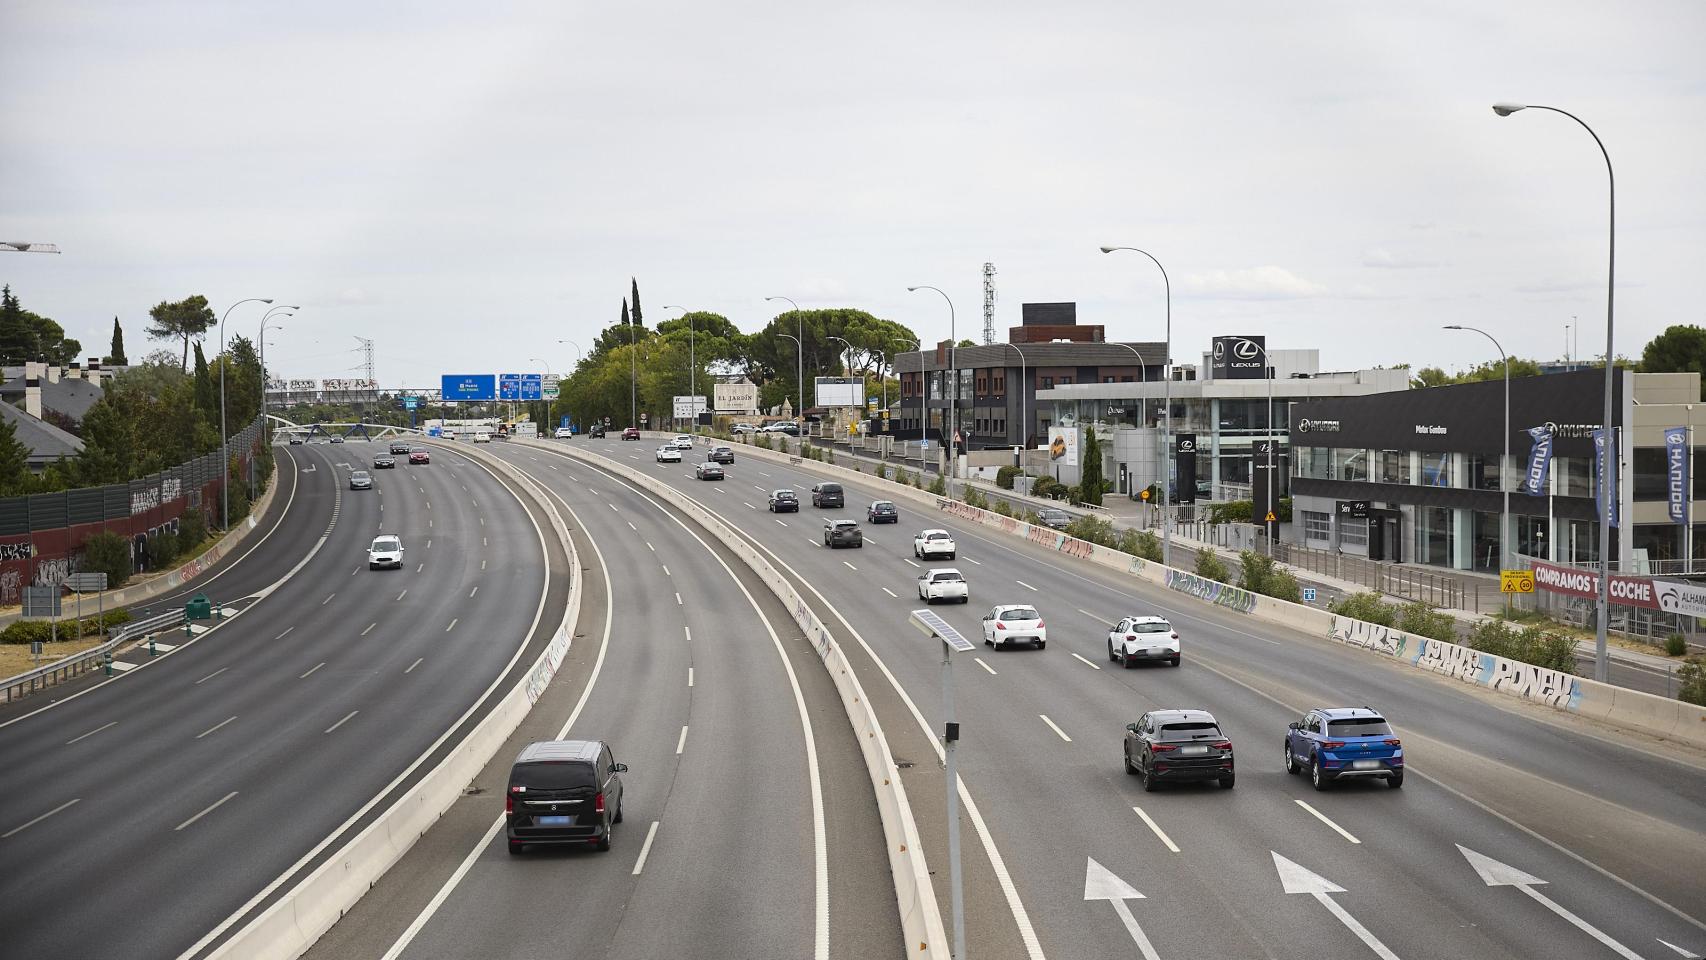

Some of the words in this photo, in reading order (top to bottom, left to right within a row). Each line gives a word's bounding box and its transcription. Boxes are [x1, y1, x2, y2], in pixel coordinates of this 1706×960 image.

[728, 394, 752, 402] JARDÍN
[1415, 424, 1429, 434] Motor
[1671, 448, 1683, 518] HYUNDAI
[1535, 566, 1591, 592] COMPRAMOS
[1609, 579, 1651, 602] COCHE
